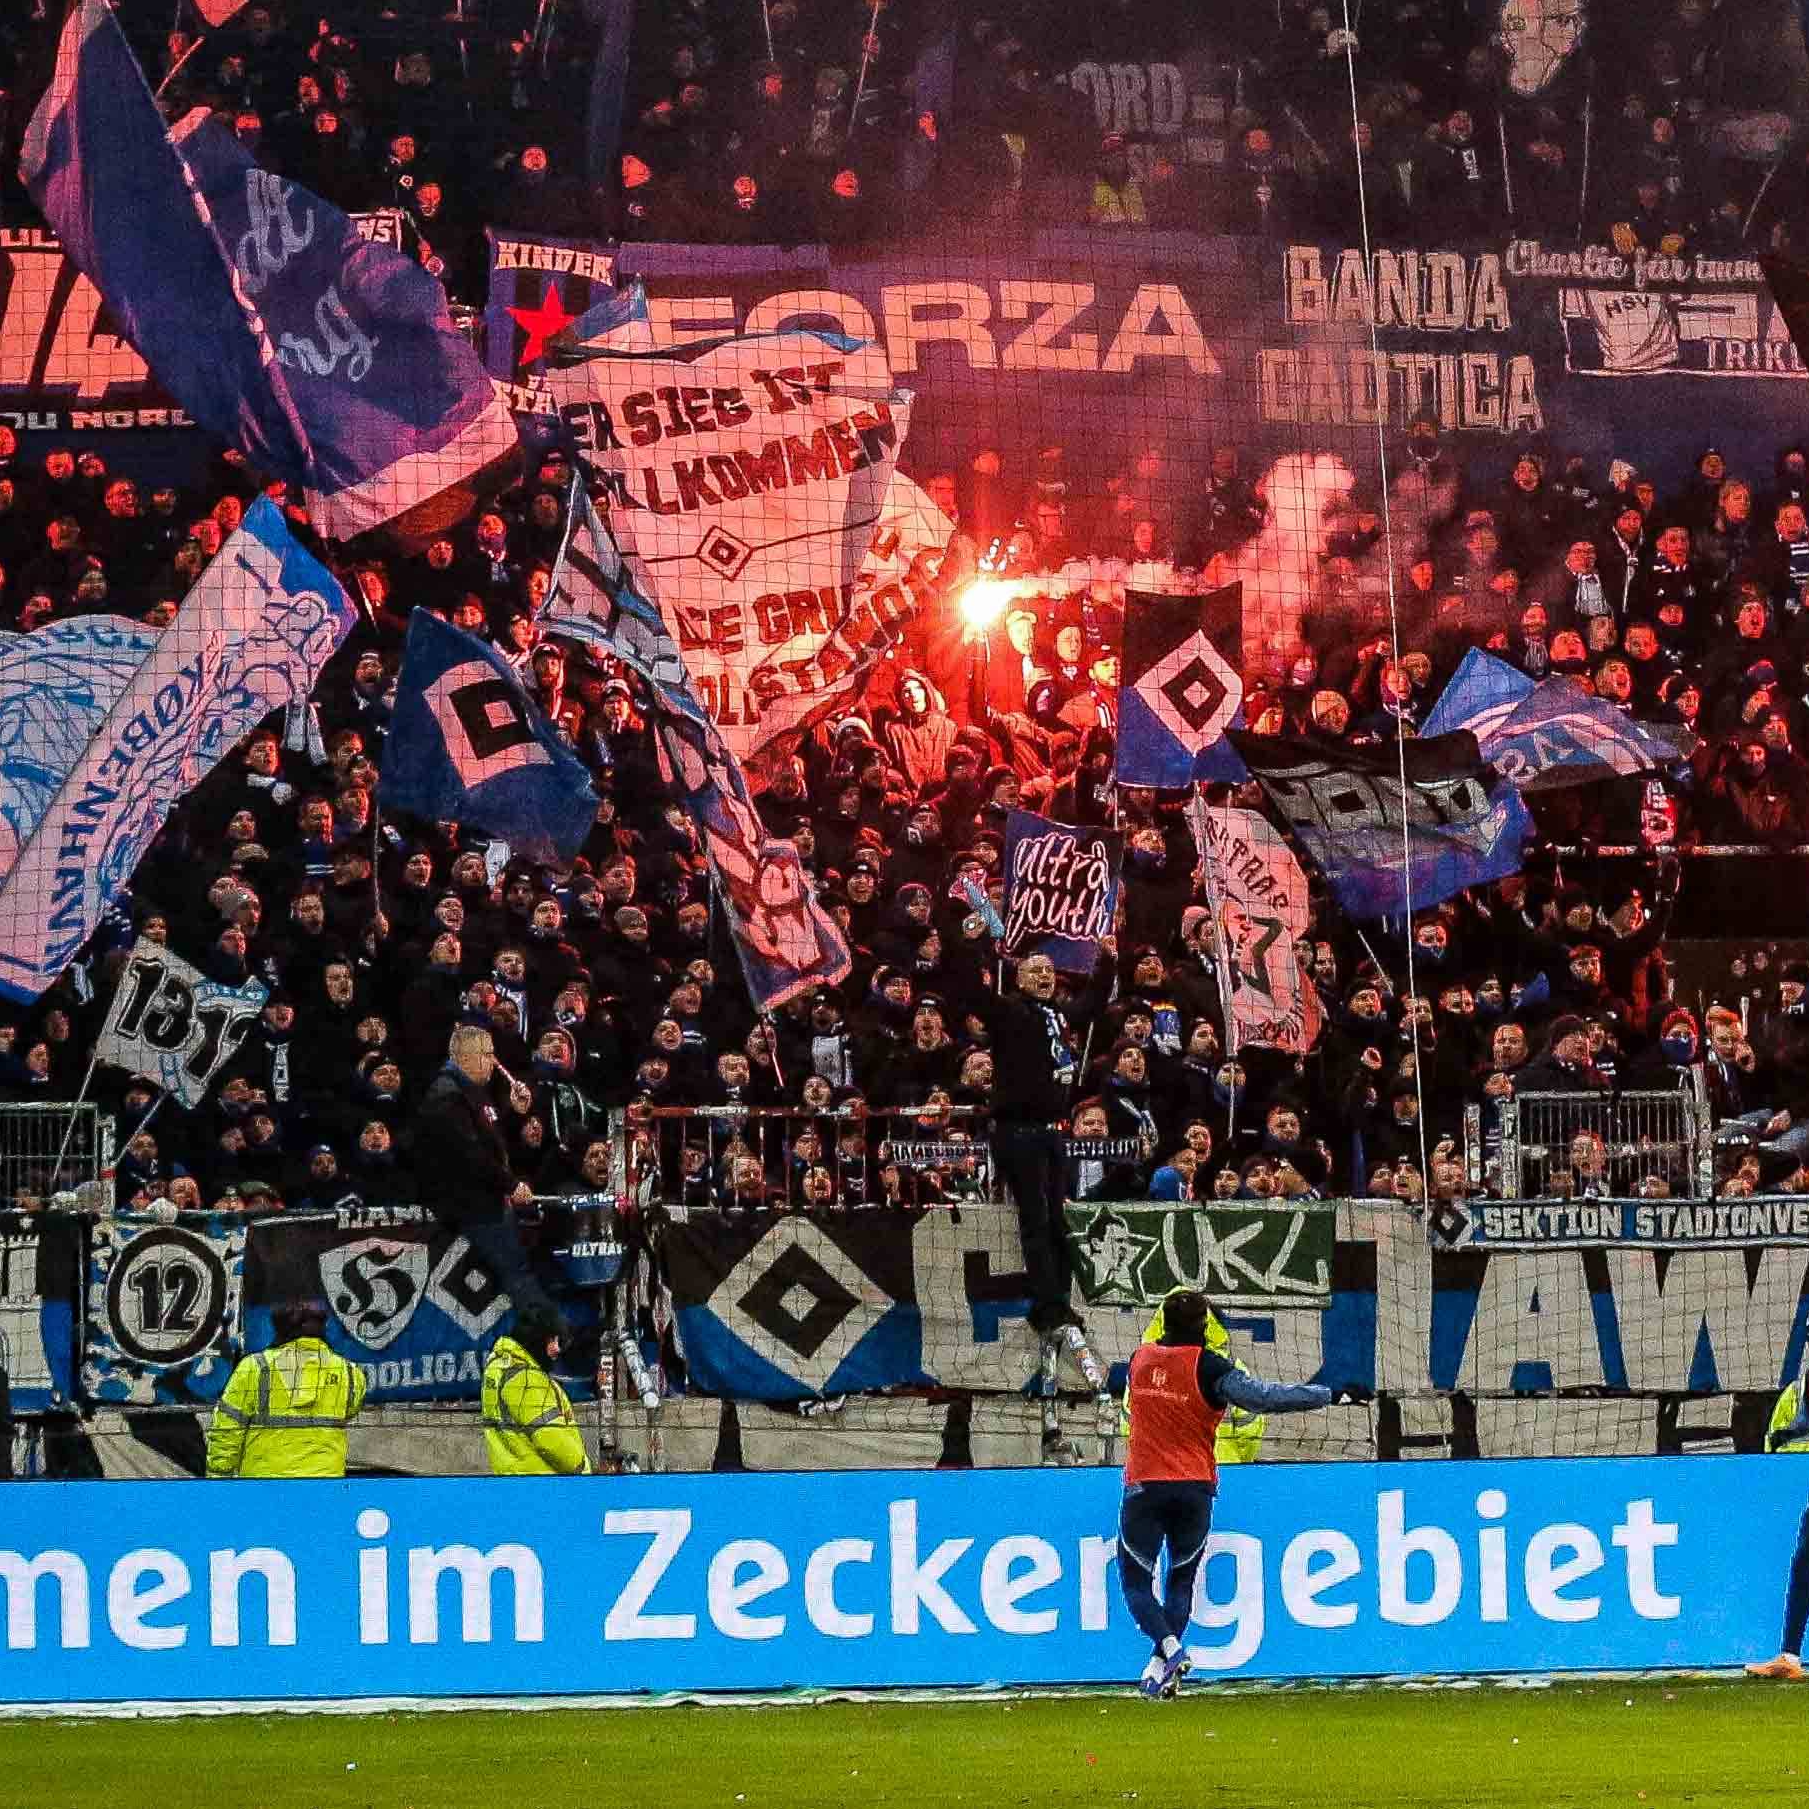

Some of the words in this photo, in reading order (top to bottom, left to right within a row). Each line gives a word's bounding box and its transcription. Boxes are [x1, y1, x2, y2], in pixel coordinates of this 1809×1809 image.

[496, 239, 615, 287] KINDER
[1284, 245, 1509, 331] BANDA
[647, 281, 1222, 374] FORZA
[621, 386, 753, 447] SIEG
[1005, 887, 1110, 953] youth
[1164, 1211, 1331, 1292] UKL
[1483, 1203, 1622, 1240] SEKTION
[128, 1260, 205, 1332] 12
[355, 1508, 548, 1647] im
[601, 1487, 1683, 1671] Zeckengebiet
